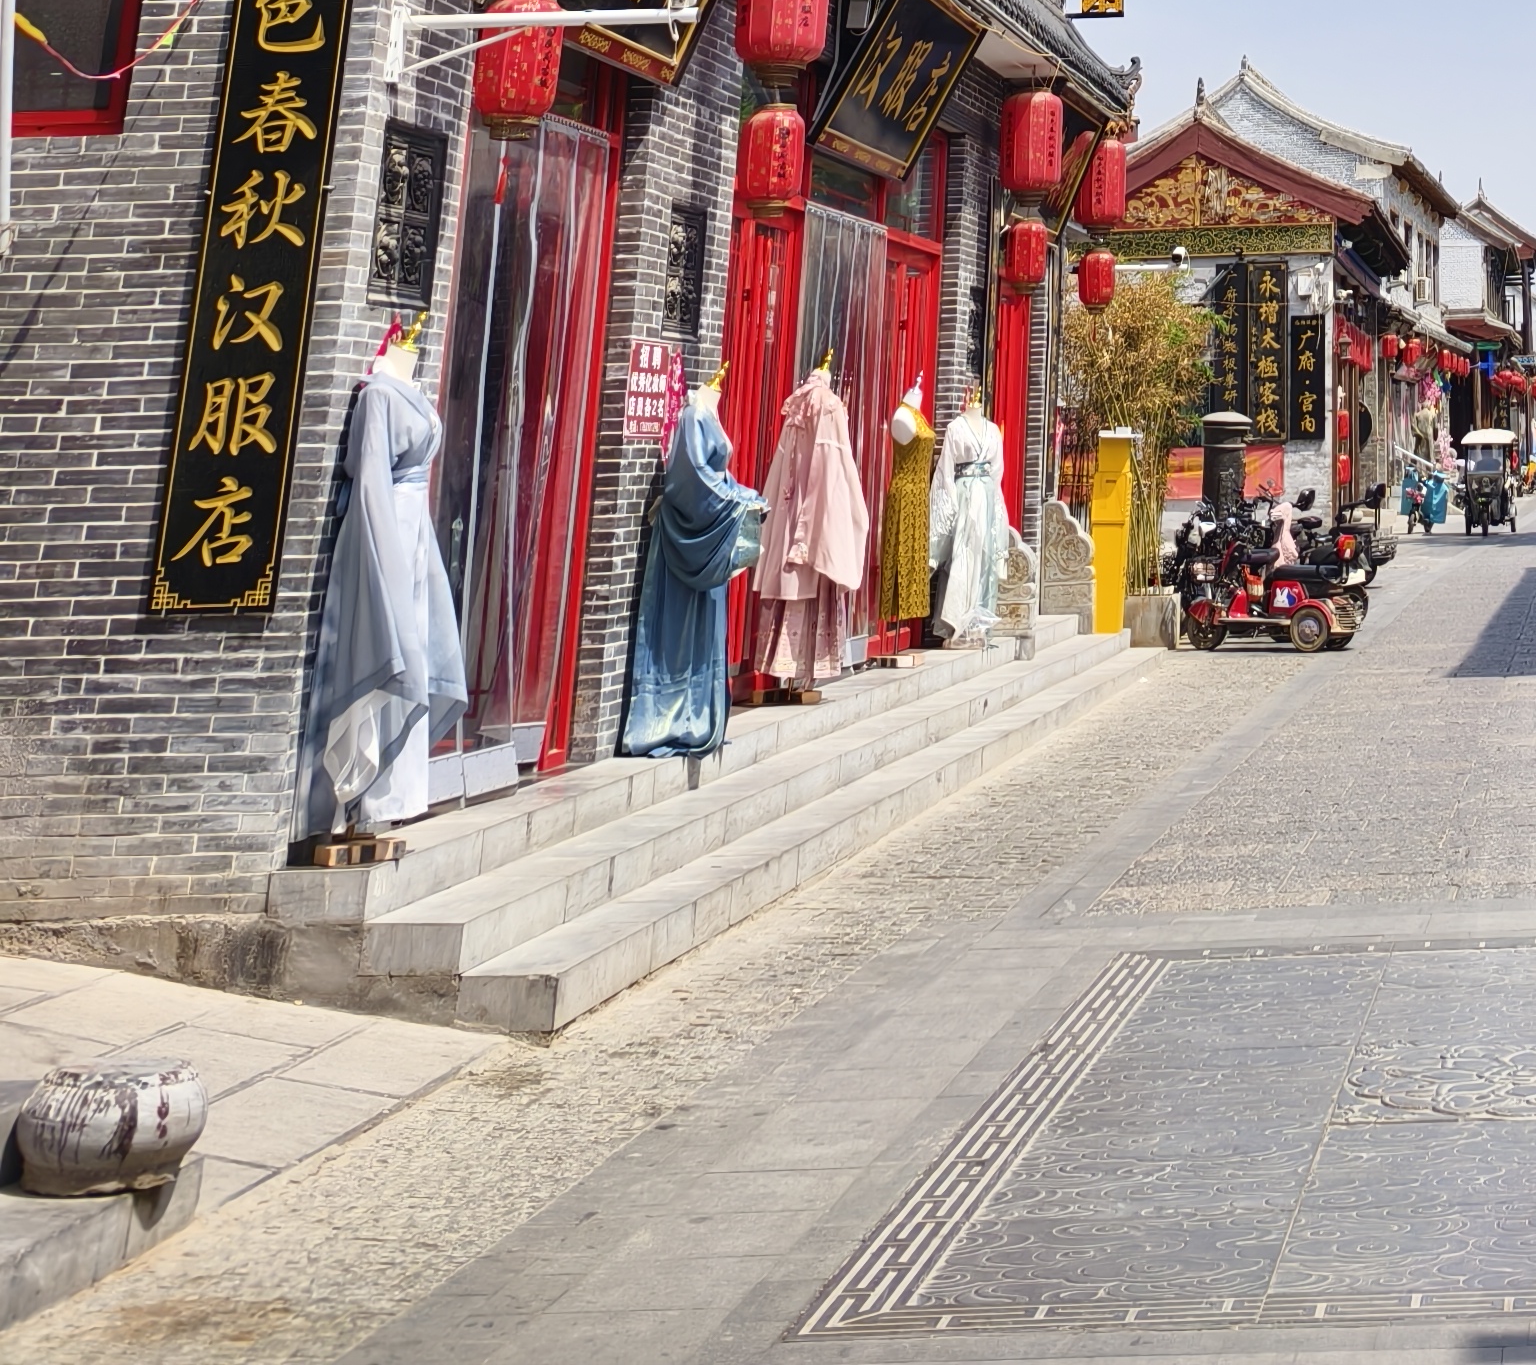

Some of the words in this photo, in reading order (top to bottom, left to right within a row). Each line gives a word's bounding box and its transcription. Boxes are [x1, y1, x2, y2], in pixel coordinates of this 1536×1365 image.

[853, 21, 951, 131] 汉服店
[640, 344, 662, 369] 招聘
